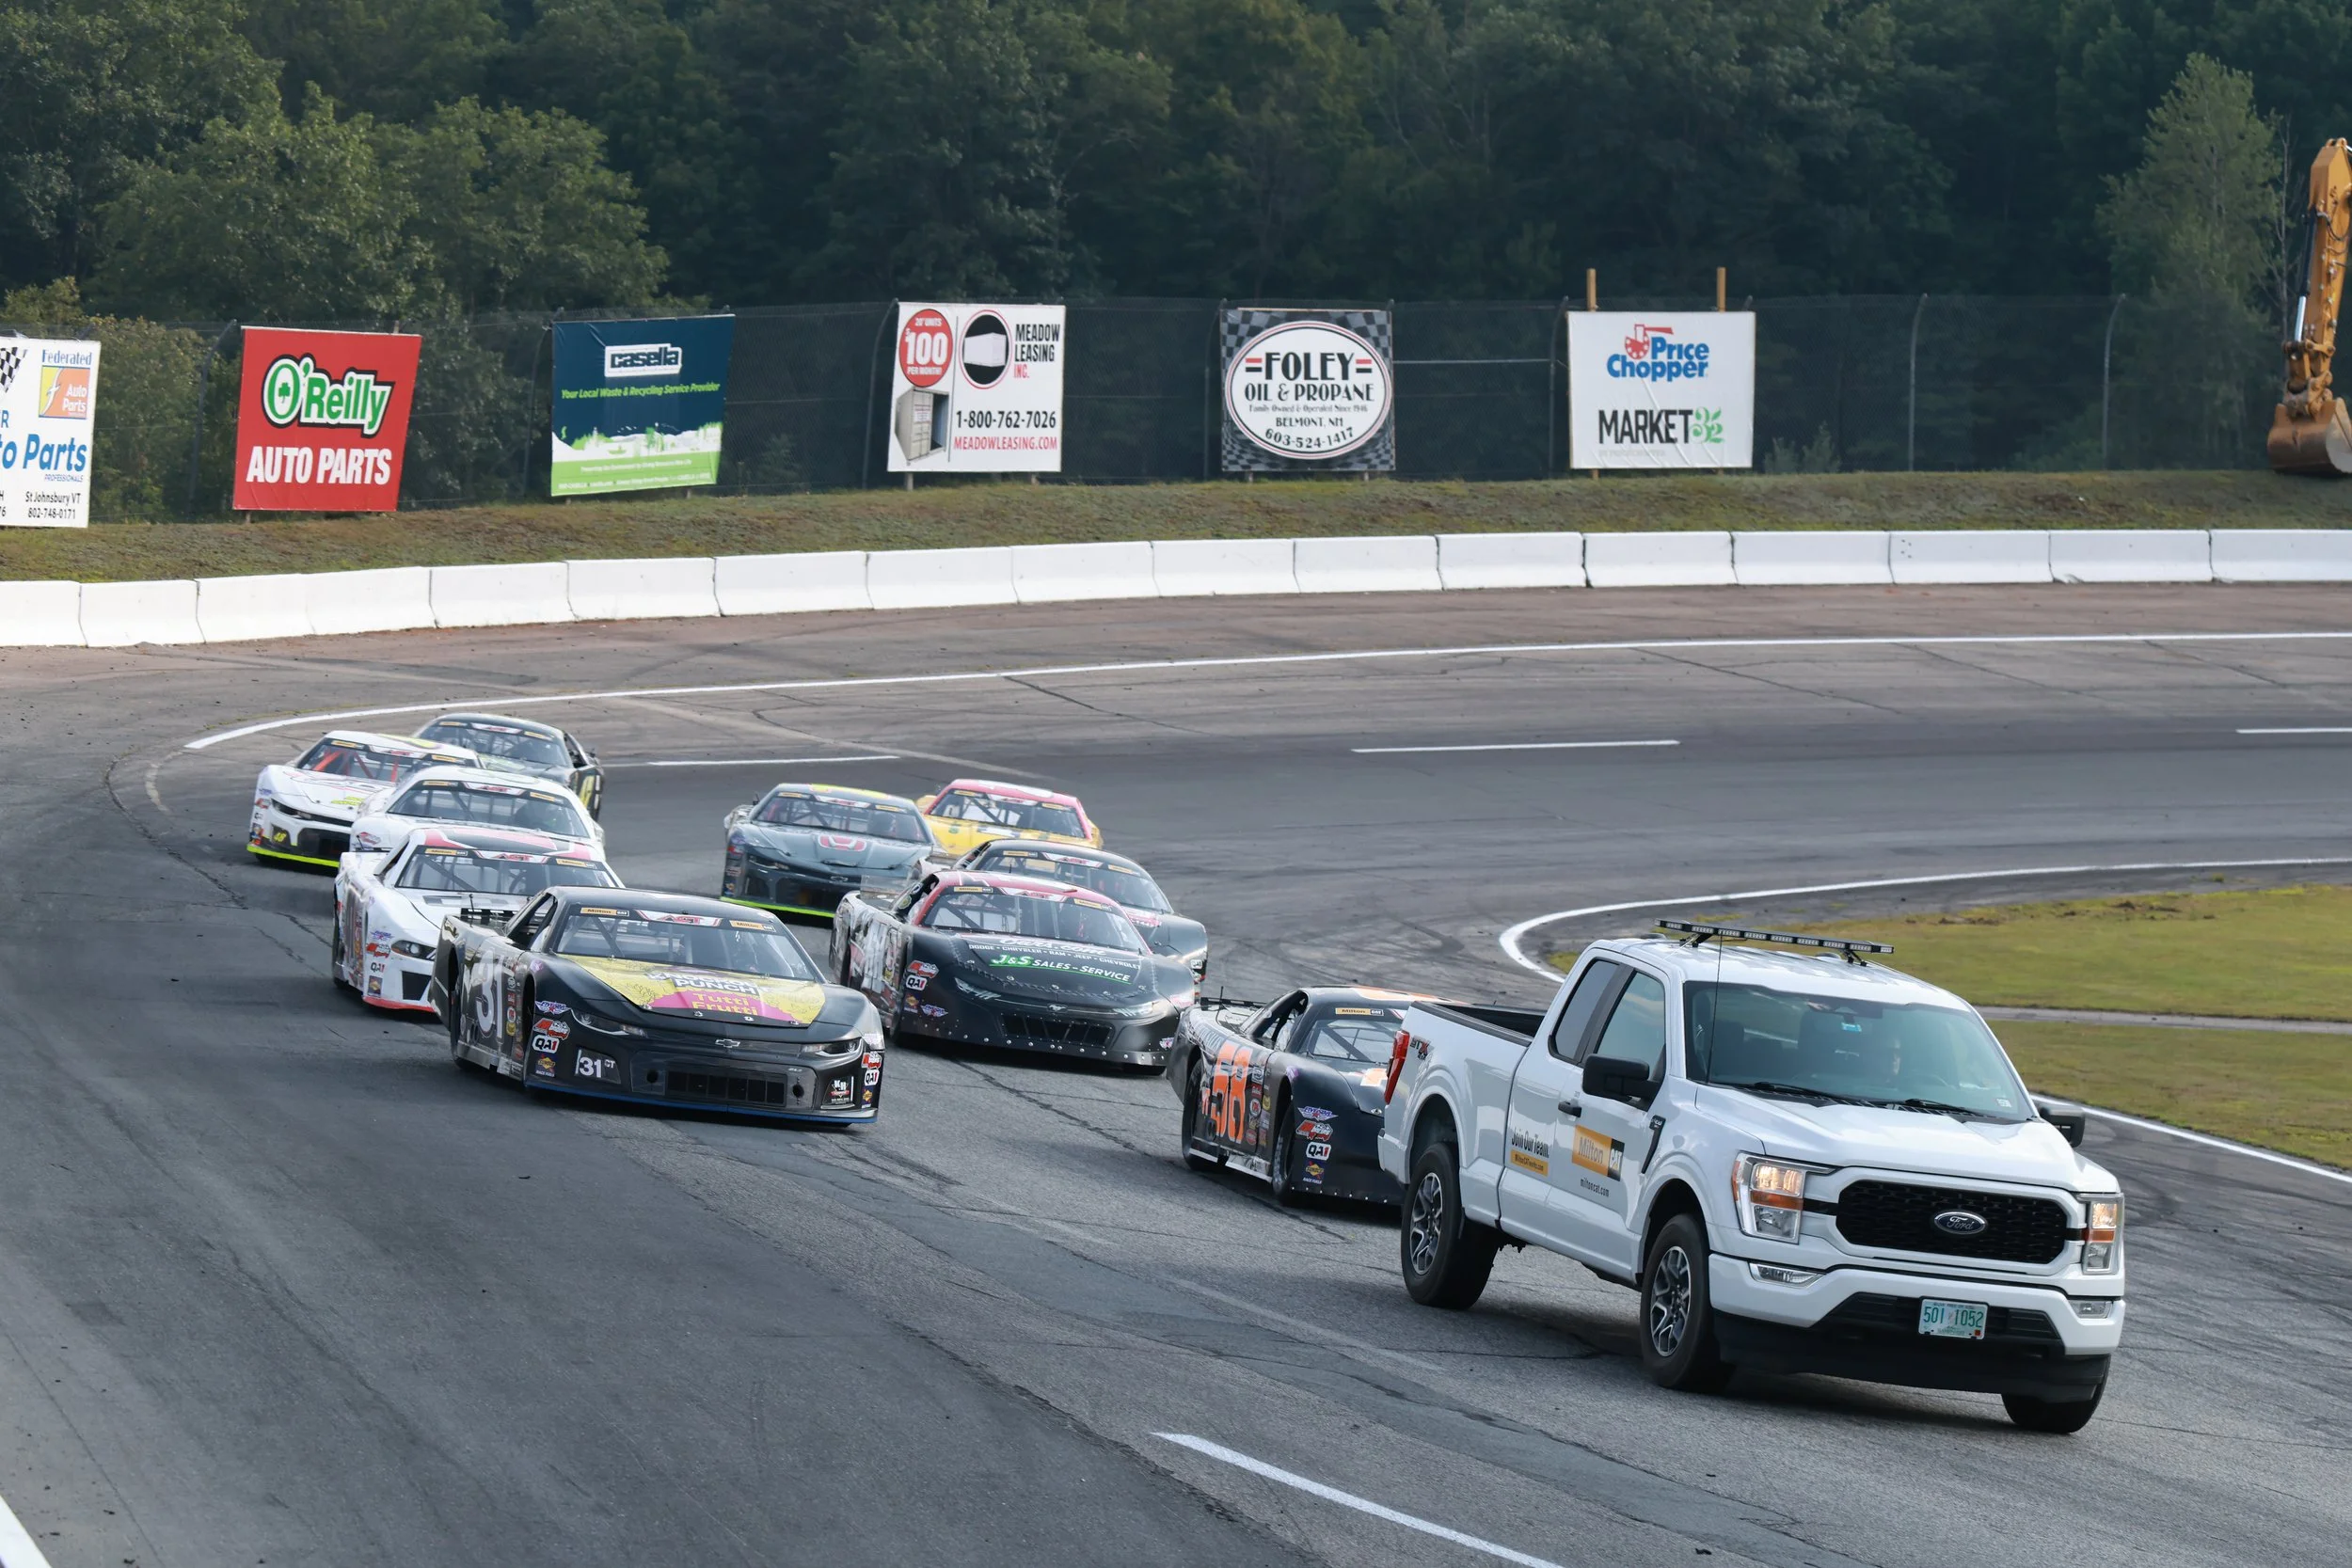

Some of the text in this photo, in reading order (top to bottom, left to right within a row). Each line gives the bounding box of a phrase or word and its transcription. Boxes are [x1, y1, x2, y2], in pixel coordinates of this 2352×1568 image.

[1015, 325, 1060, 341] MEADOW
[42, 349, 92, 366] Federated
[611, 346, 679, 368] casella
[1015, 344, 1055, 362] LEASING
[1651, 337, 1709, 360] Price
[907, 367, 918, 375] PER
[1013, 364, 1029, 378] INC.
[1264, 352, 1355, 381] FOLEY
[1607, 354, 1708, 382] Chopper
[66, 384, 87, 398] Auto
[266, 356, 391, 436] O'Reilly
[562, 389, 579, 399] Your
[579, 388, 598, 398] Local
[599, 388, 622, 397] Waste
[629, 385, 663, 396] Recycling
[663, 384, 690, 394] Service
[690, 381, 721, 391] Provider
[1245, 383, 1375, 402] OIL & PROPANE
[62, 398, 87, 412] Parts
[956, 410, 1057, 428] 1-800-762-7026
[1598, 409, 1692, 444] MARKET
[954, 436, 1057, 451] MEADOWLEASING.COM
[1265, 426, 1353, 449] 603-524-1417
[23, 434, 87, 472] Parts
[246, 446, 391, 485] AUTO PARTS
[25, 491, 81, 506] St Johnsbury VT
[991, 954, 1033, 965] J&S
[1032, 959, 1071, 970] SALES
[1079, 965, 1130, 981] SERVICE
[1099, 958, 1141, 970] CHEVROLET
[675, 978, 756, 995] PUNCH
[692, 993, 749, 1006] Tutti
[692, 1001, 758, 1015] Frutti
[535, 1037, 557, 1050] QA1
[580, 1056, 615, 1078] 31 CT
[1512, 1127, 1523, 1148] Join
[1524, 1131, 1534, 1152] Our
[1309, 1145, 1329, 1157] QA1
[1579, 1137, 1604, 1164] Milton
[1581, 1178, 1610, 1197] miltoncat.com
[1947, 1216, 1975, 1229] Ford
[1923, 1306, 1984, 1328] 501 1052
